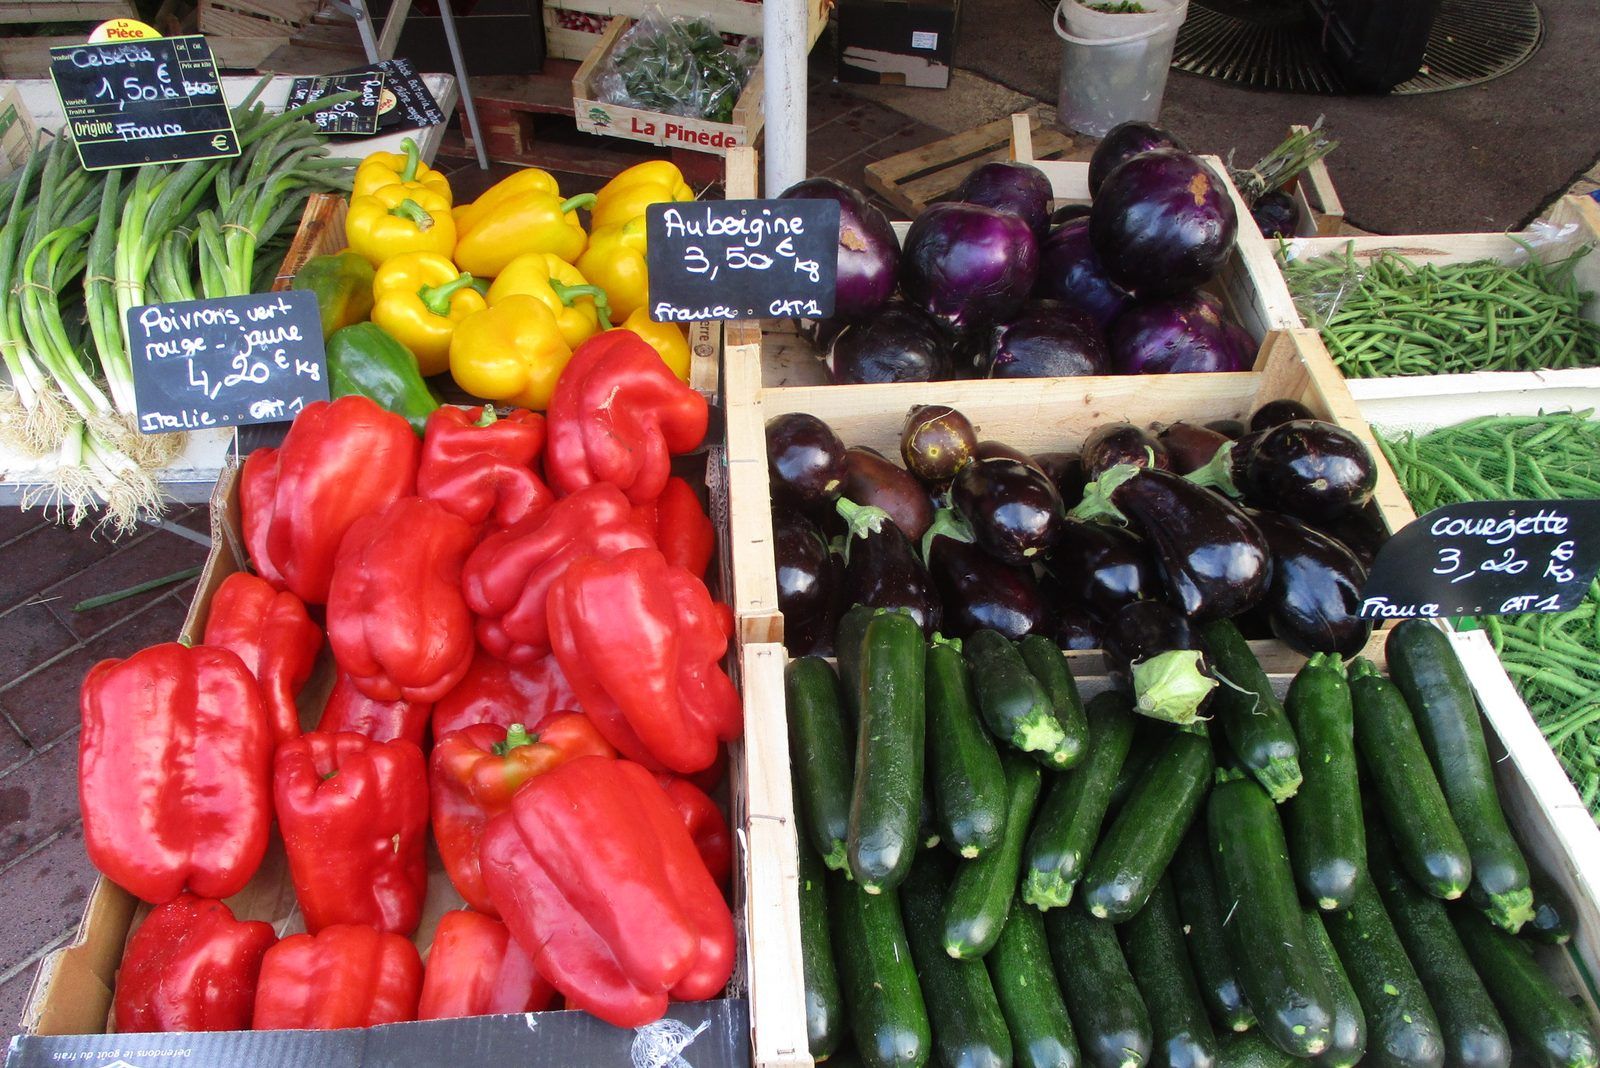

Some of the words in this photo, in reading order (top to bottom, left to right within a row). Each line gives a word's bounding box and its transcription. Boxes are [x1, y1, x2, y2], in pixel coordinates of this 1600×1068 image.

[107, 28, 143, 38] Pièce
[95, 77, 158, 111] 1,50
[360, 80, 382, 107] Radis
[75, 120, 114, 138] Origine
[115, 122, 186, 142] France
[631, 117, 656, 136] La
[211, 134, 230, 151] €
[684, 246, 775, 281] 3,50
[140, 306, 240, 337] Poivrons
[246, 297, 292, 322] vert
[144, 337, 206, 361] rouge
[238, 325, 303, 358] jaune
[188, 356, 270, 400] 4,20
[141, 409, 216, 431] Italie
[1432, 548, 1529, 584] 3,20
[52, 1051, 77, 1062] frais
[80, 1050, 94, 1060] du
